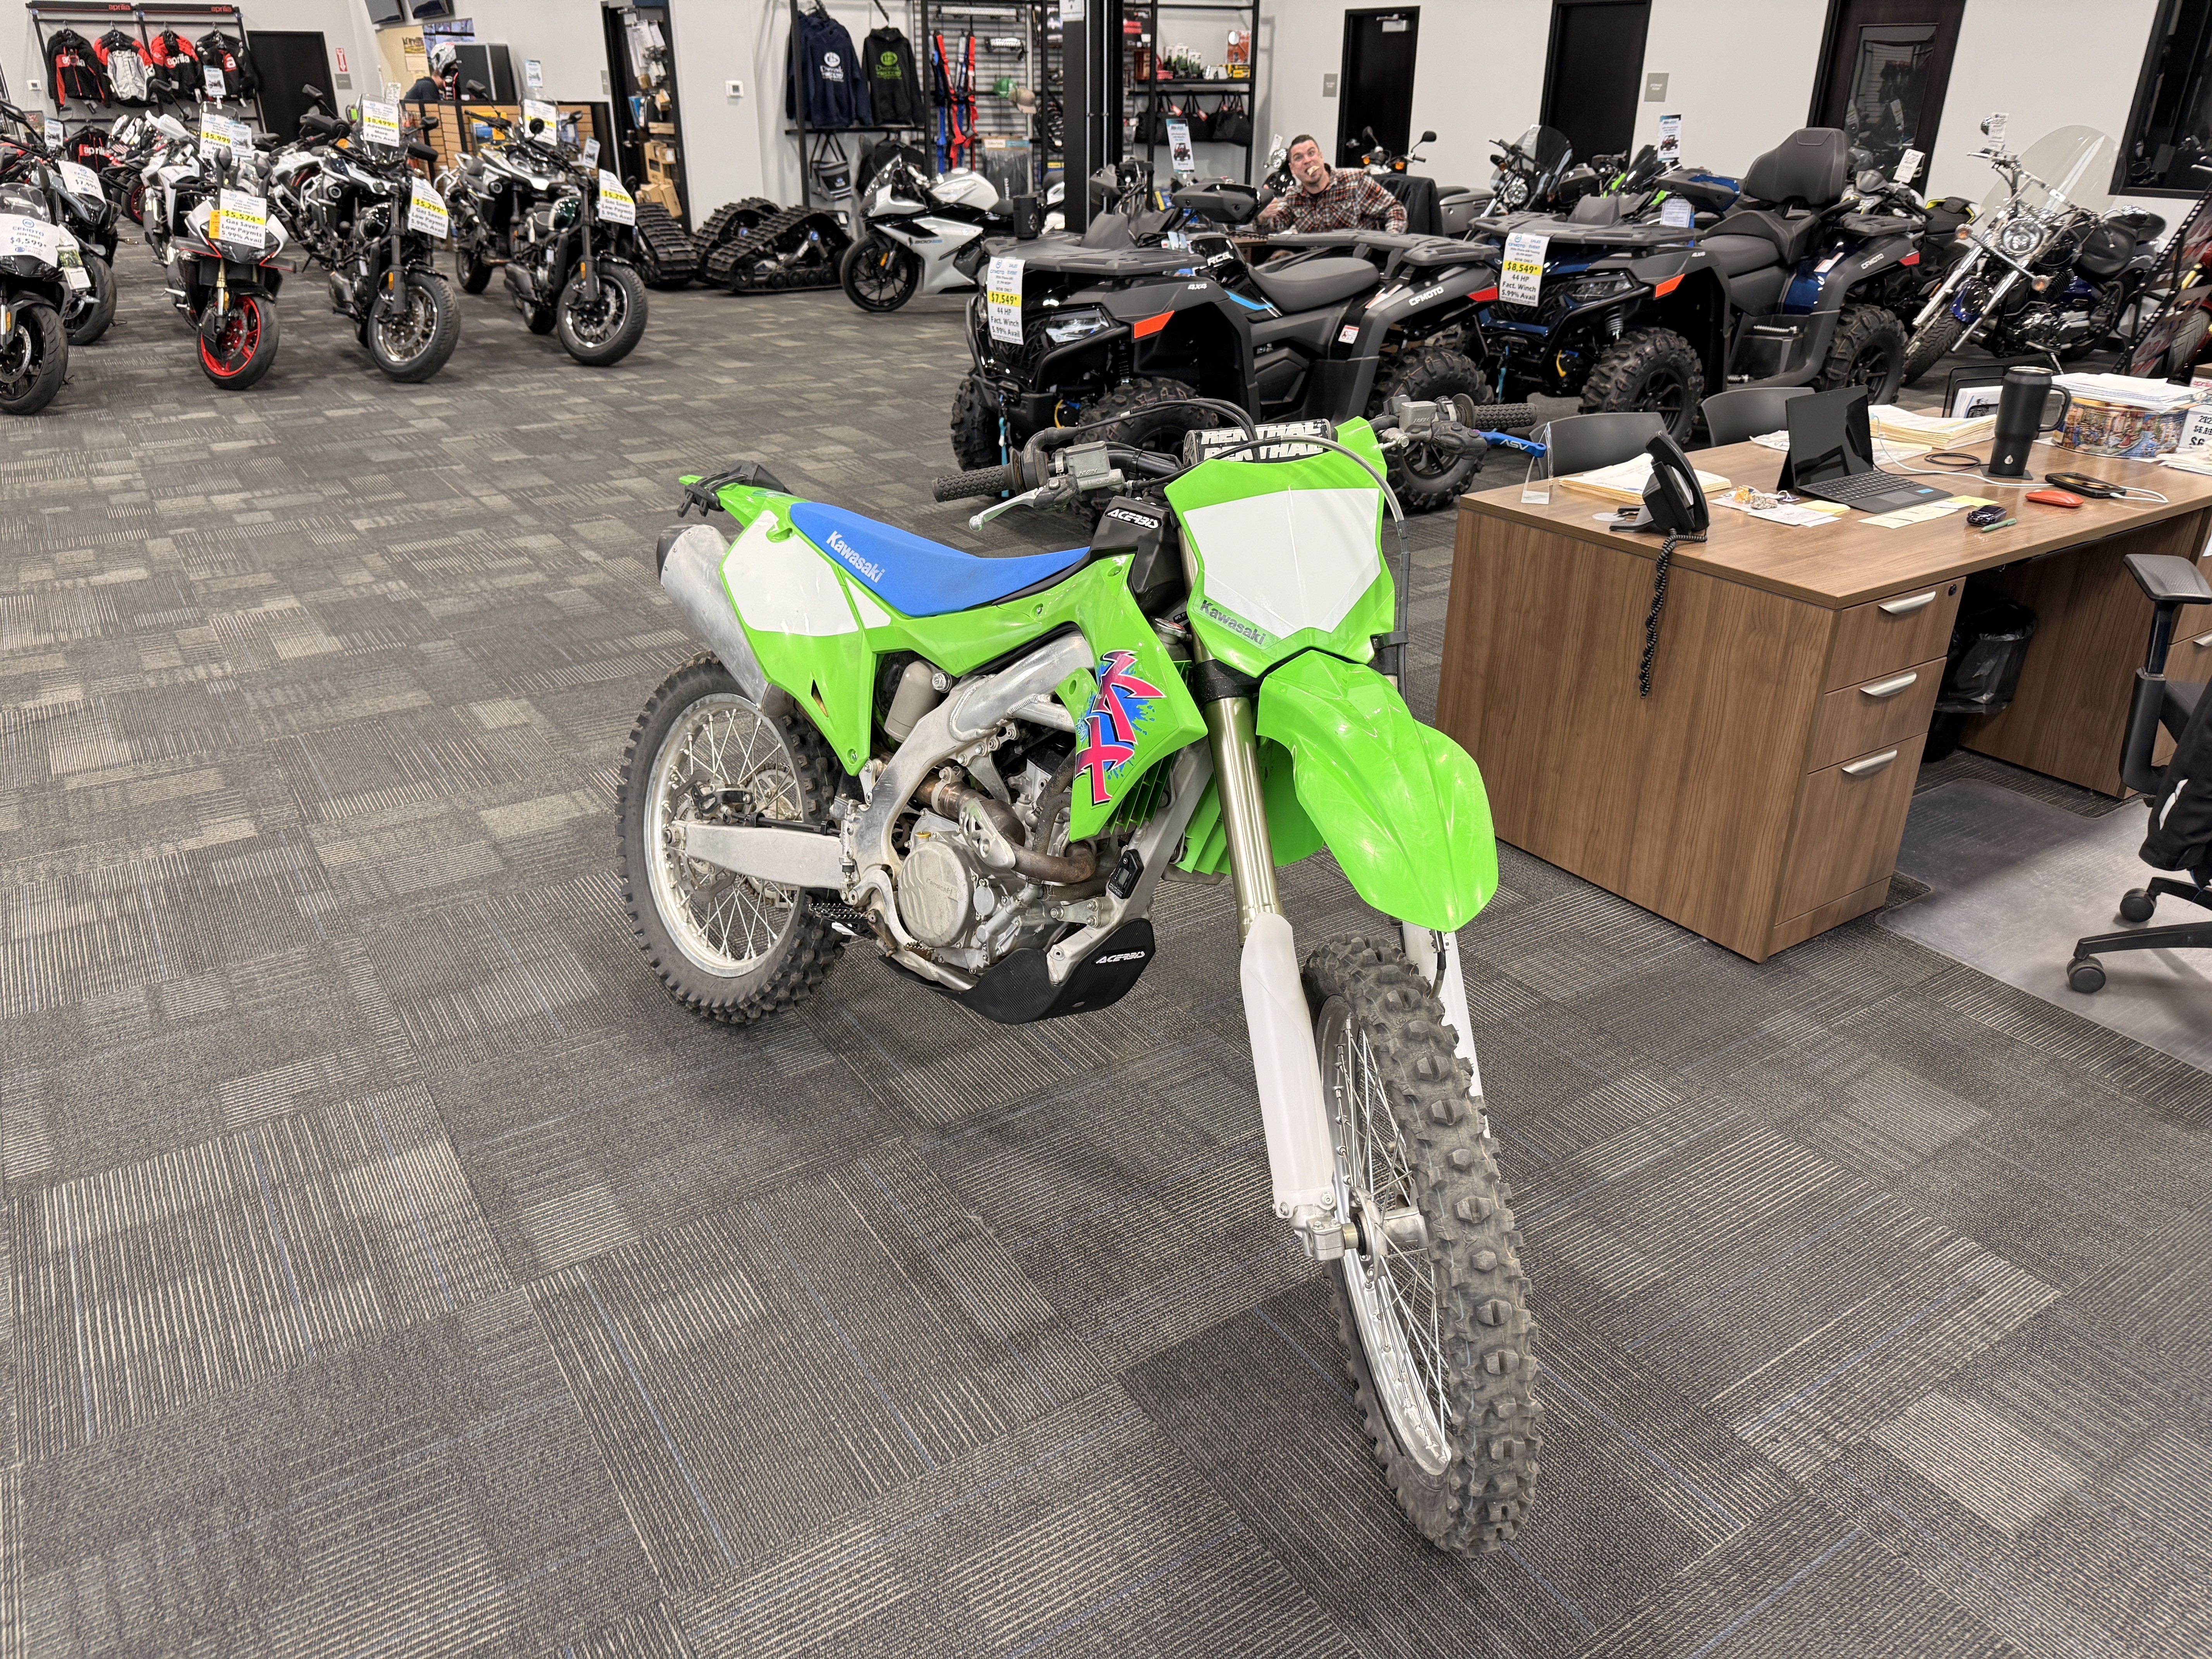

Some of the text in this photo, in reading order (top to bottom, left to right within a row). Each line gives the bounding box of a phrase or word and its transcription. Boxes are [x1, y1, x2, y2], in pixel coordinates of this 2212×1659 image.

[166, 53, 190, 65] aprilia
[84, 146, 105, 155] aprili
[428, 211, 443, 220] Saver
[240, 221, 259, 230] Saver
[425, 217, 445, 228] Paymts
[222, 230, 242, 239] 5.99%
[238, 227, 262, 237] Paymts
[1861, 253, 1884, 269] CFMOTO
[1518, 284, 1536, 292] Winch
[1409, 287, 1444, 306] CFMOTO
[1502, 290, 1519, 298] 5.99%
[991, 316, 1019, 327] Fact. Winch
[992, 326, 1020, 338] 5.99% Avail
[1201, 422, 1321, 445] RENTHAL
[1499, 439, 1529, 450] ASV
[1107, 508, 1158, 529] ACERBIS
[826, 531, 885, 583] Kawasaki
[1200, 599, 1266, 645] Kawasaki
[1096, 951, 1145, 964] ACERBIS
